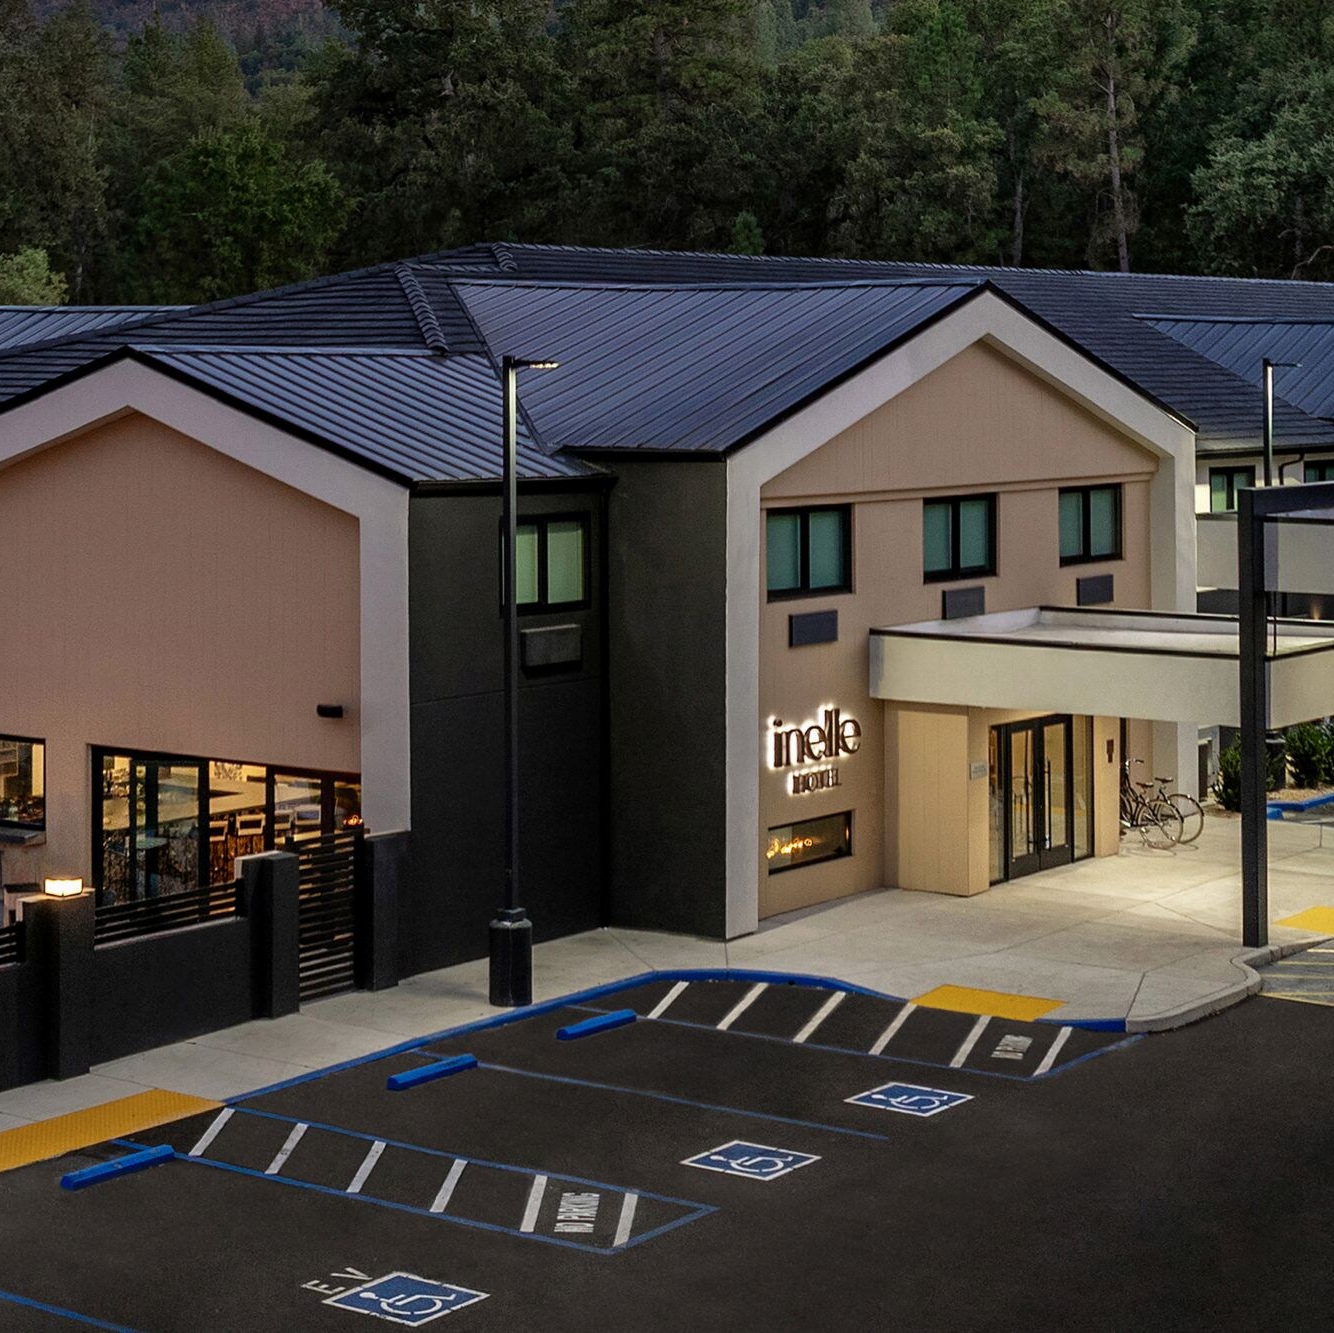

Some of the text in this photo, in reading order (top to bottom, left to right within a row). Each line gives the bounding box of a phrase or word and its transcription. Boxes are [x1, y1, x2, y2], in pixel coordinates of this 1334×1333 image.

[772, 708, 862, 767] inelle
[792, 767, 842, 794] HOTEL
[554, 1192, 600, 1233] NO PARKING
[301, 1267, 373, 1295] EV
